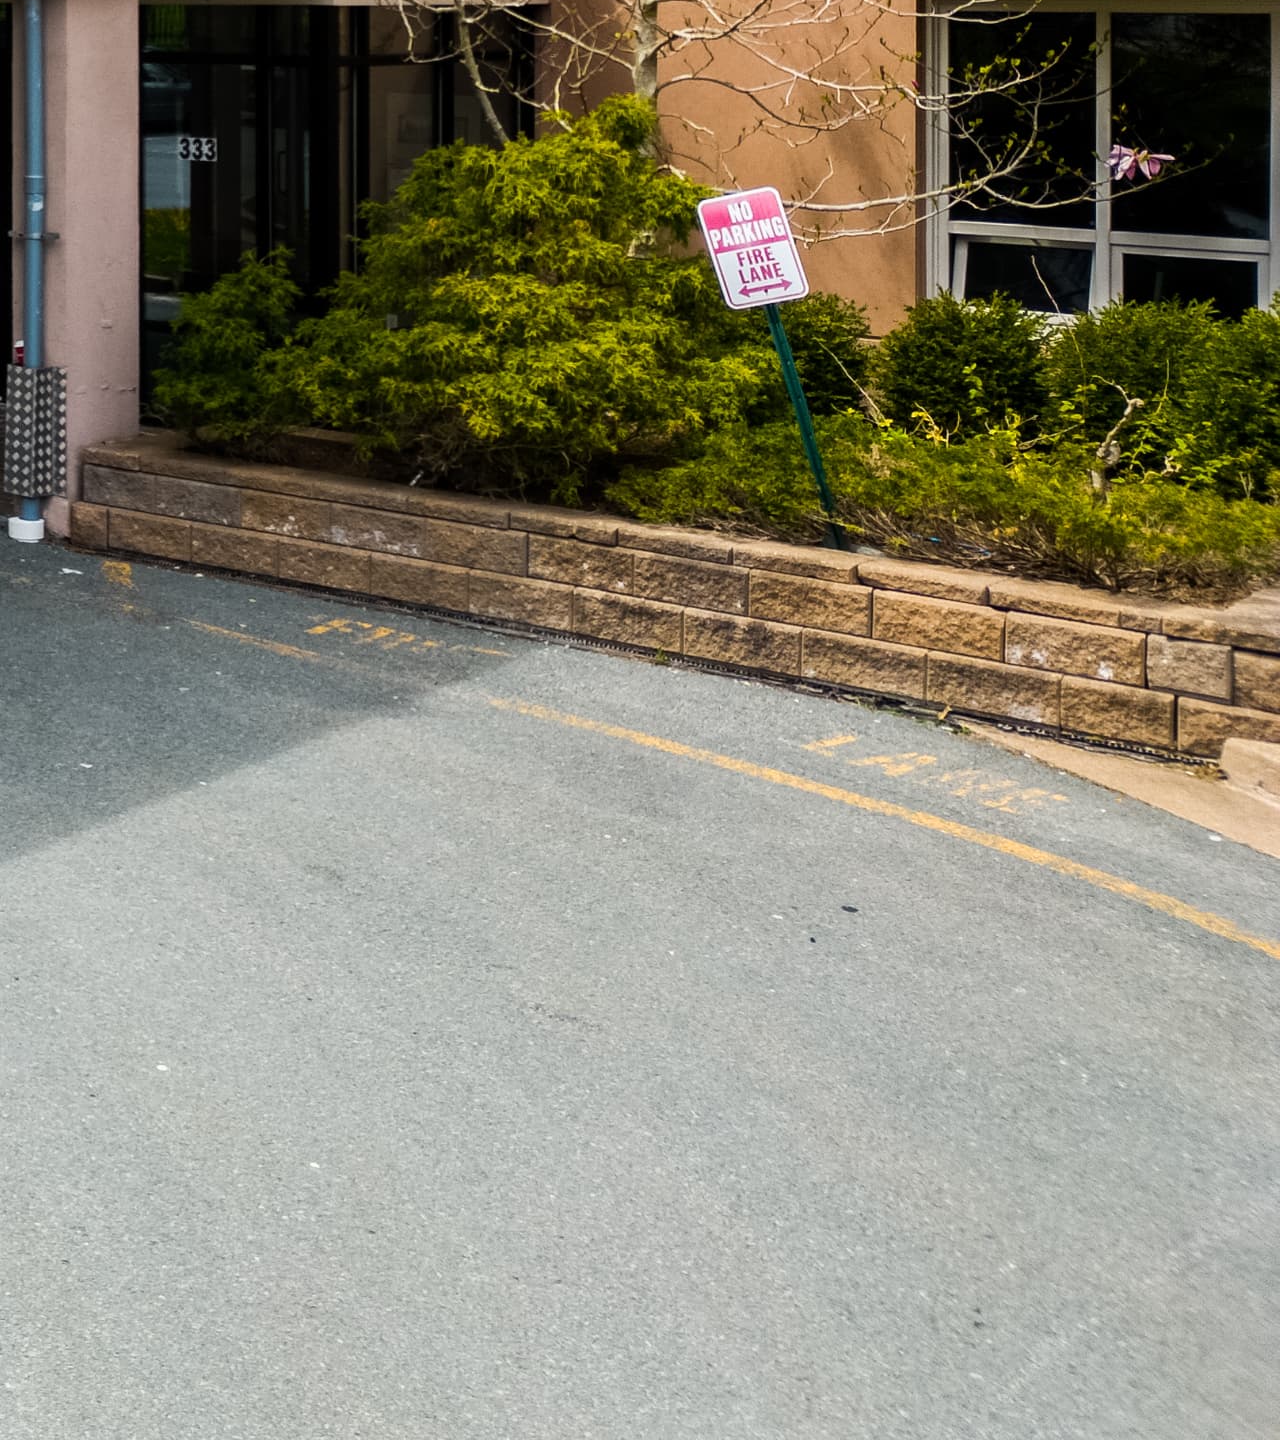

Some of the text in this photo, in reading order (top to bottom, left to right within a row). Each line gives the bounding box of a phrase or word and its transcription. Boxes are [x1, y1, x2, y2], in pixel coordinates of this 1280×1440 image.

[179, 138, 216, 160] 333
[727, 200, 753, 223] NO
[709, 216, 786, 250] PARKING
[736, 246, 775, 267] FIRE
[739, 262, 784, 284] LANE
